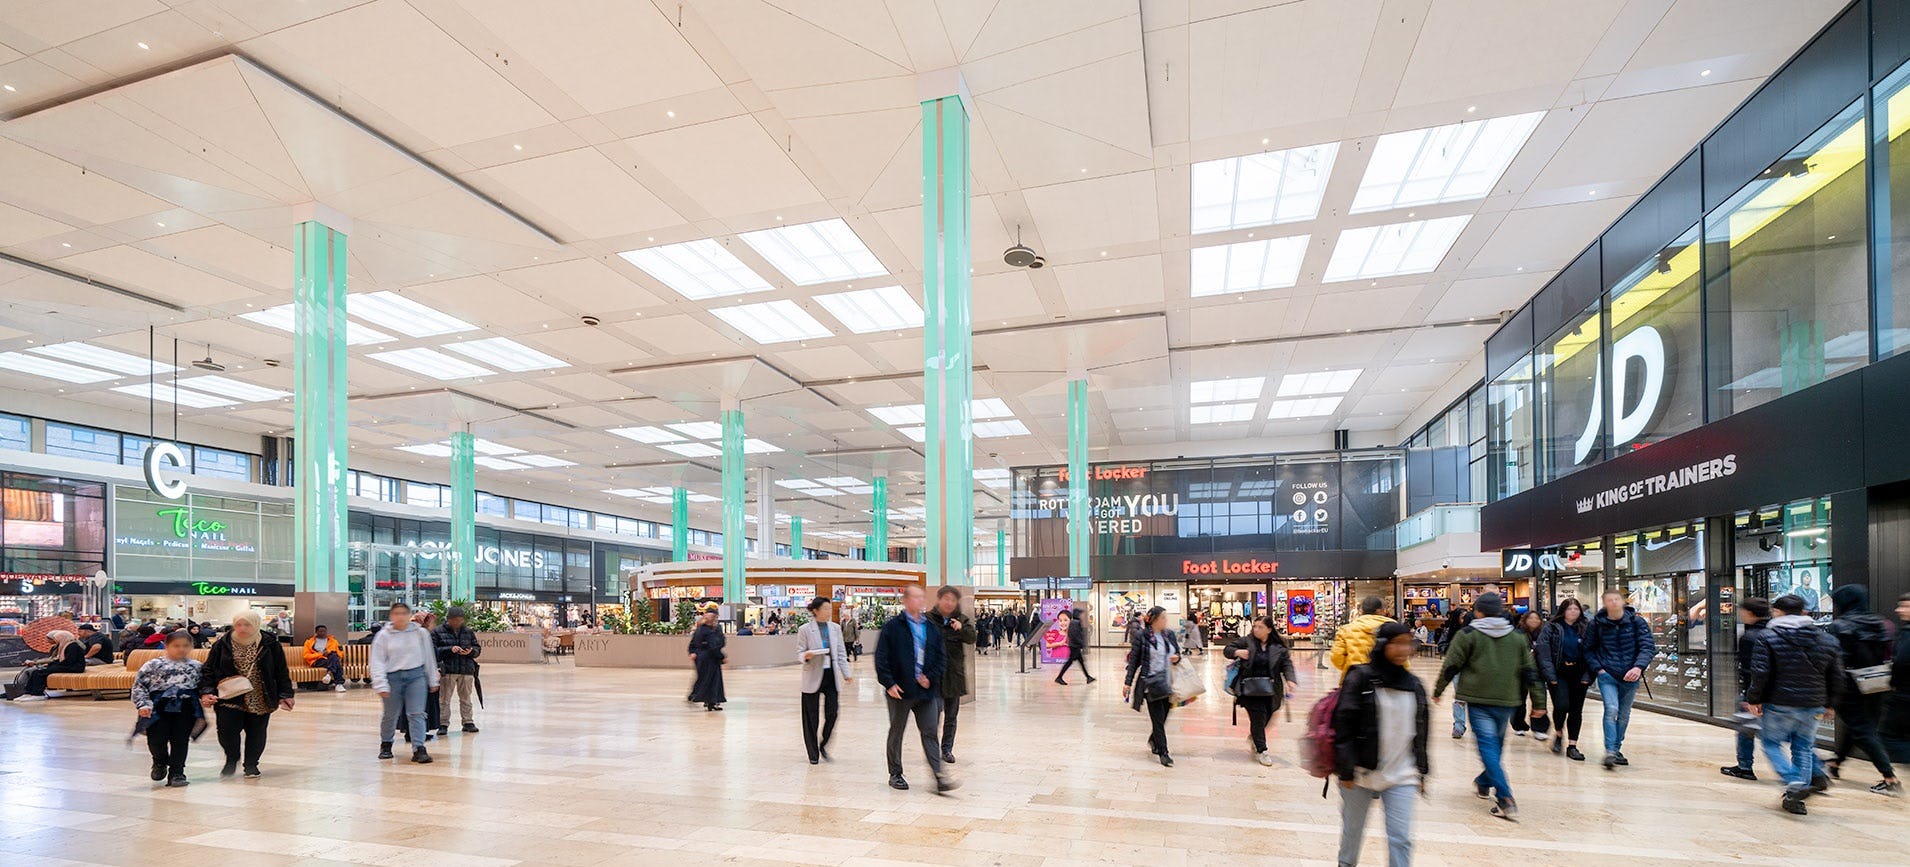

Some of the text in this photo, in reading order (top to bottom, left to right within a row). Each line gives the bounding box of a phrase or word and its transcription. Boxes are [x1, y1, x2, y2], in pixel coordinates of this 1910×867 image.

[1574, 325, 1665, 465] JD
[145, 441, 187, 499] C
[1095, 465, 1147, 480] Locker
[1596, 454, 1737, 509] KING OF TRAINERS
[1101, 509, 1121, 518] GOT
[1124, 494, 1179, 517] YOU
[474, 545, 544, 568] JONES
[1505, 554, 1534, 572] JD
[1183, 559, 1279, 575] Foot Locker
[231, 586, 257, 595] NAIL
[480, 636, 526, 648] nchroom
[578, 639, 610, 651] ARTY
